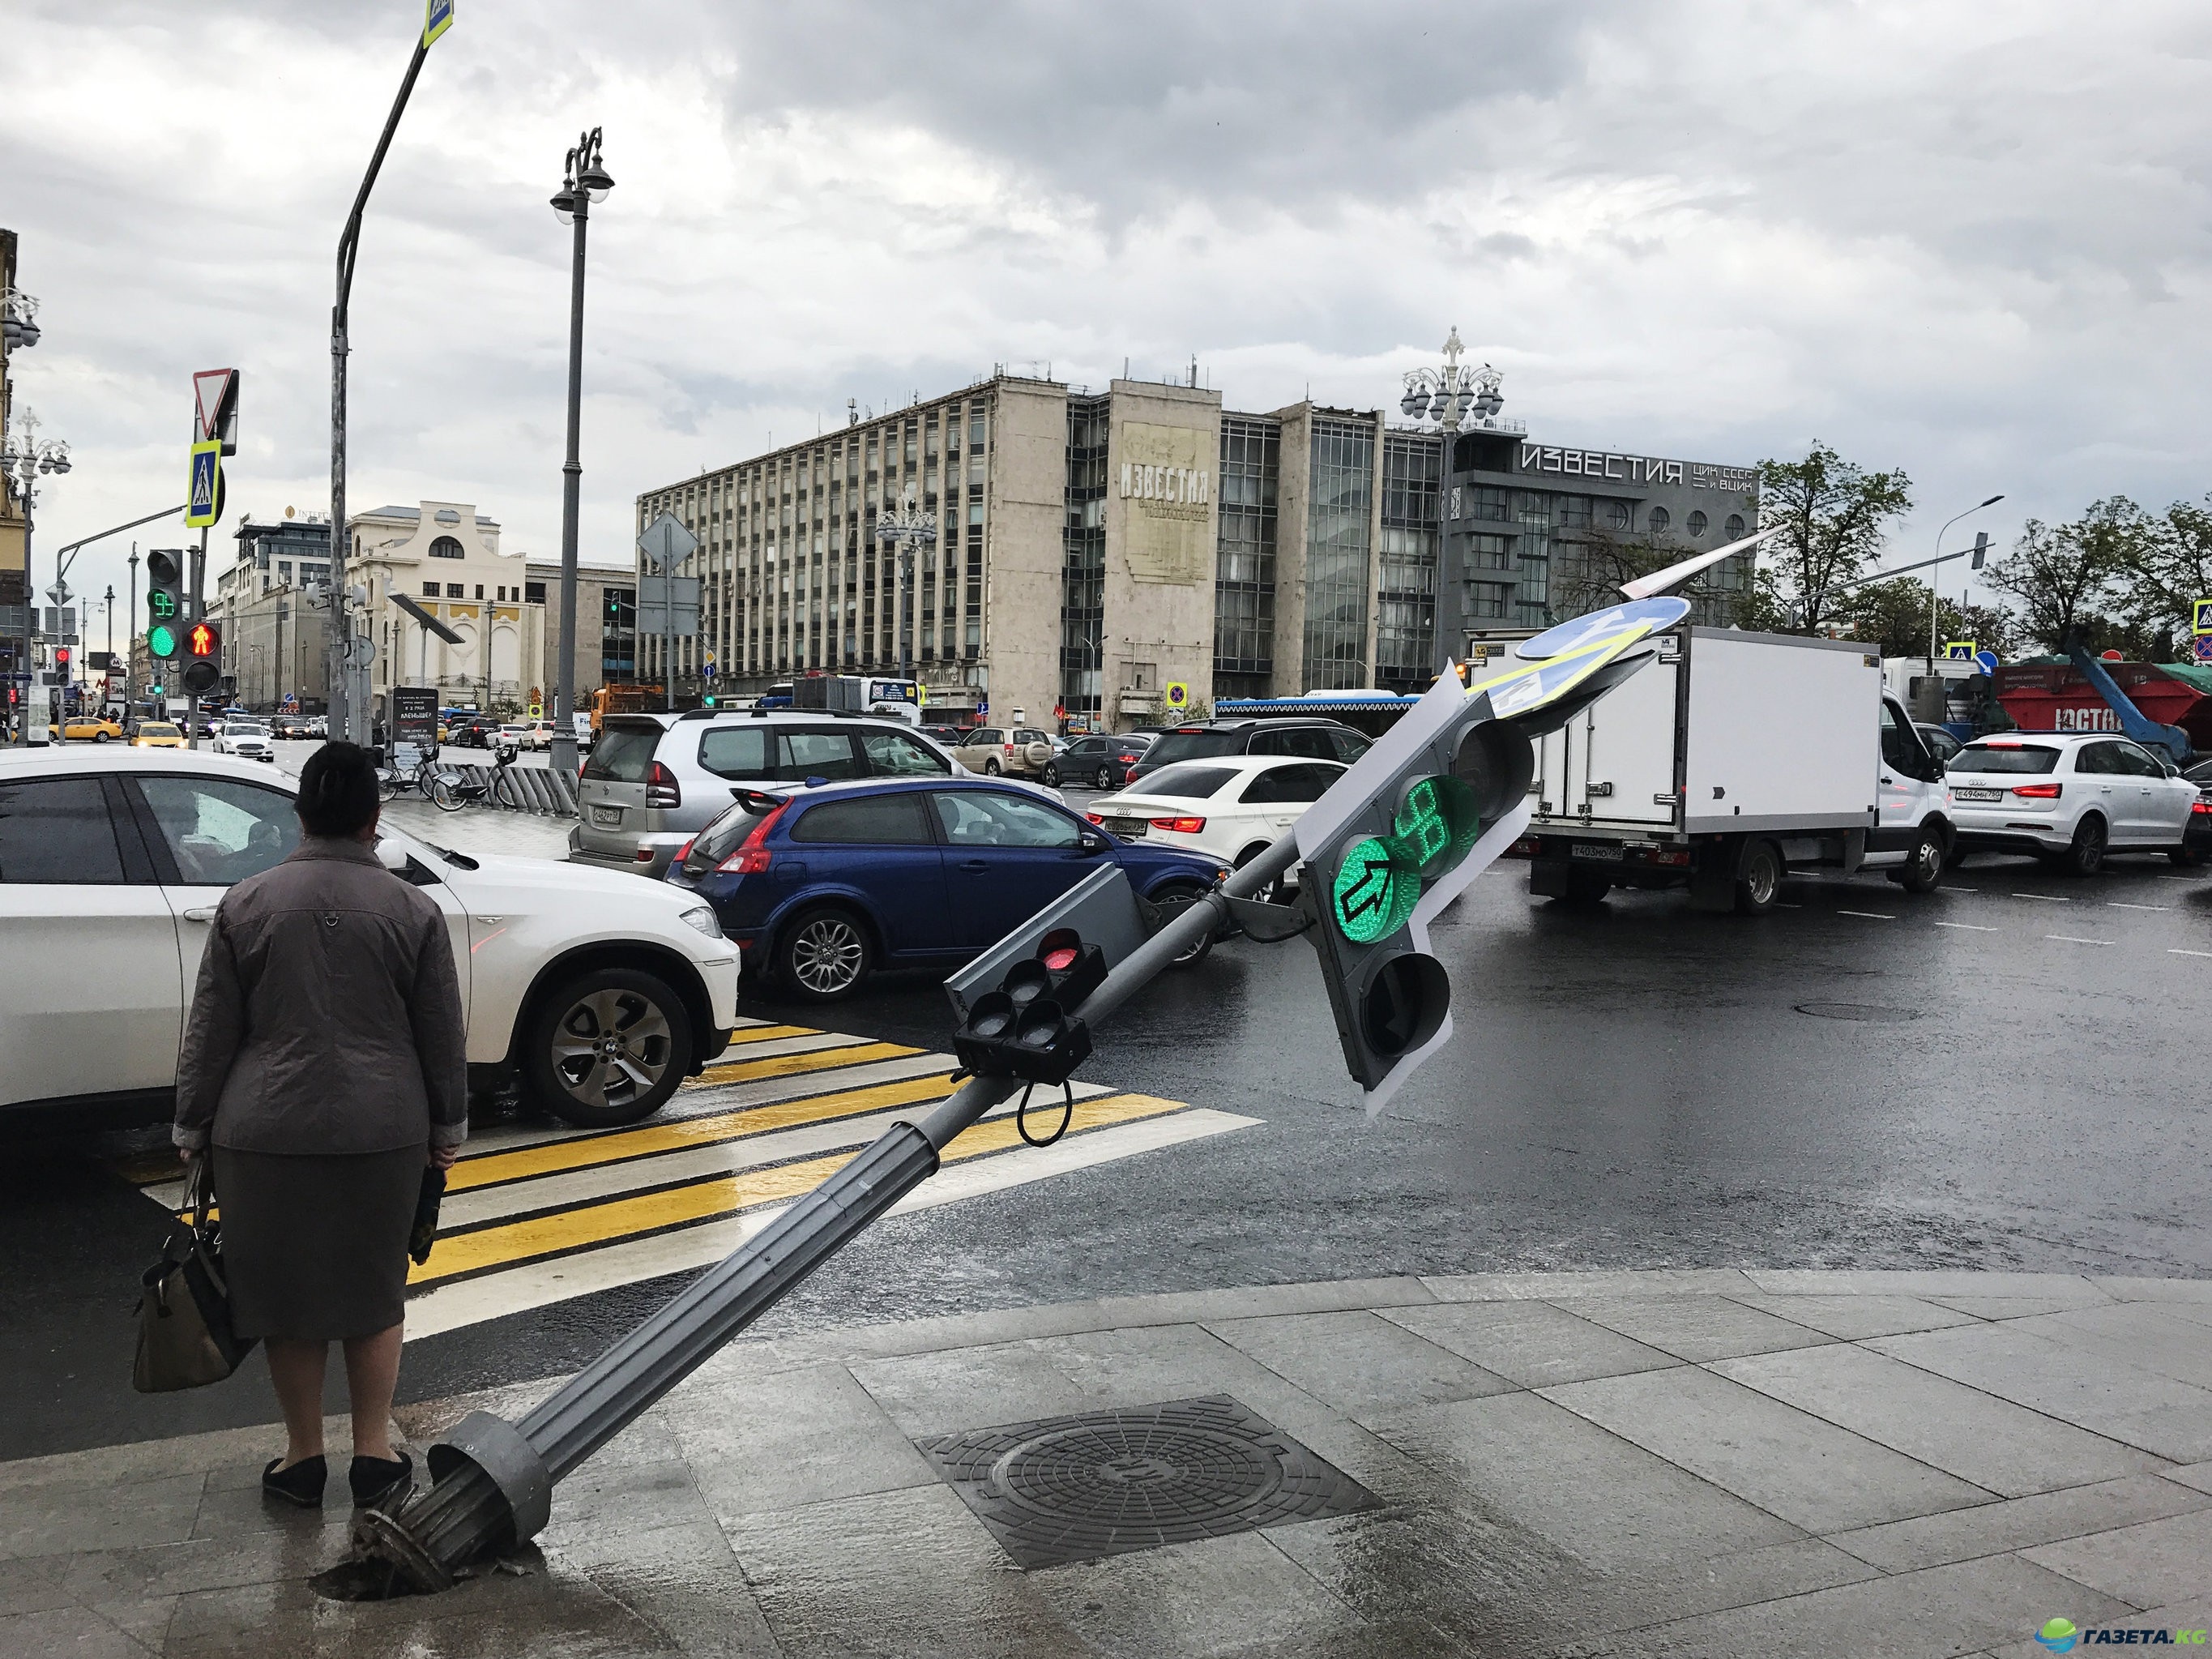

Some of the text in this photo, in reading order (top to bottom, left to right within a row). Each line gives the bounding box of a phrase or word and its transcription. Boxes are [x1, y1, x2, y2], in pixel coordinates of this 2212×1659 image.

[1522, 445, 1683, 485] ИЗВЕСТИЯ
[1693, 464, 1753, 480] ЦИК СССР
[1120, 462, 1208, 503] ИЗВЕСТИЯ
[1719, 479, 1753, 493] ВЦИК
